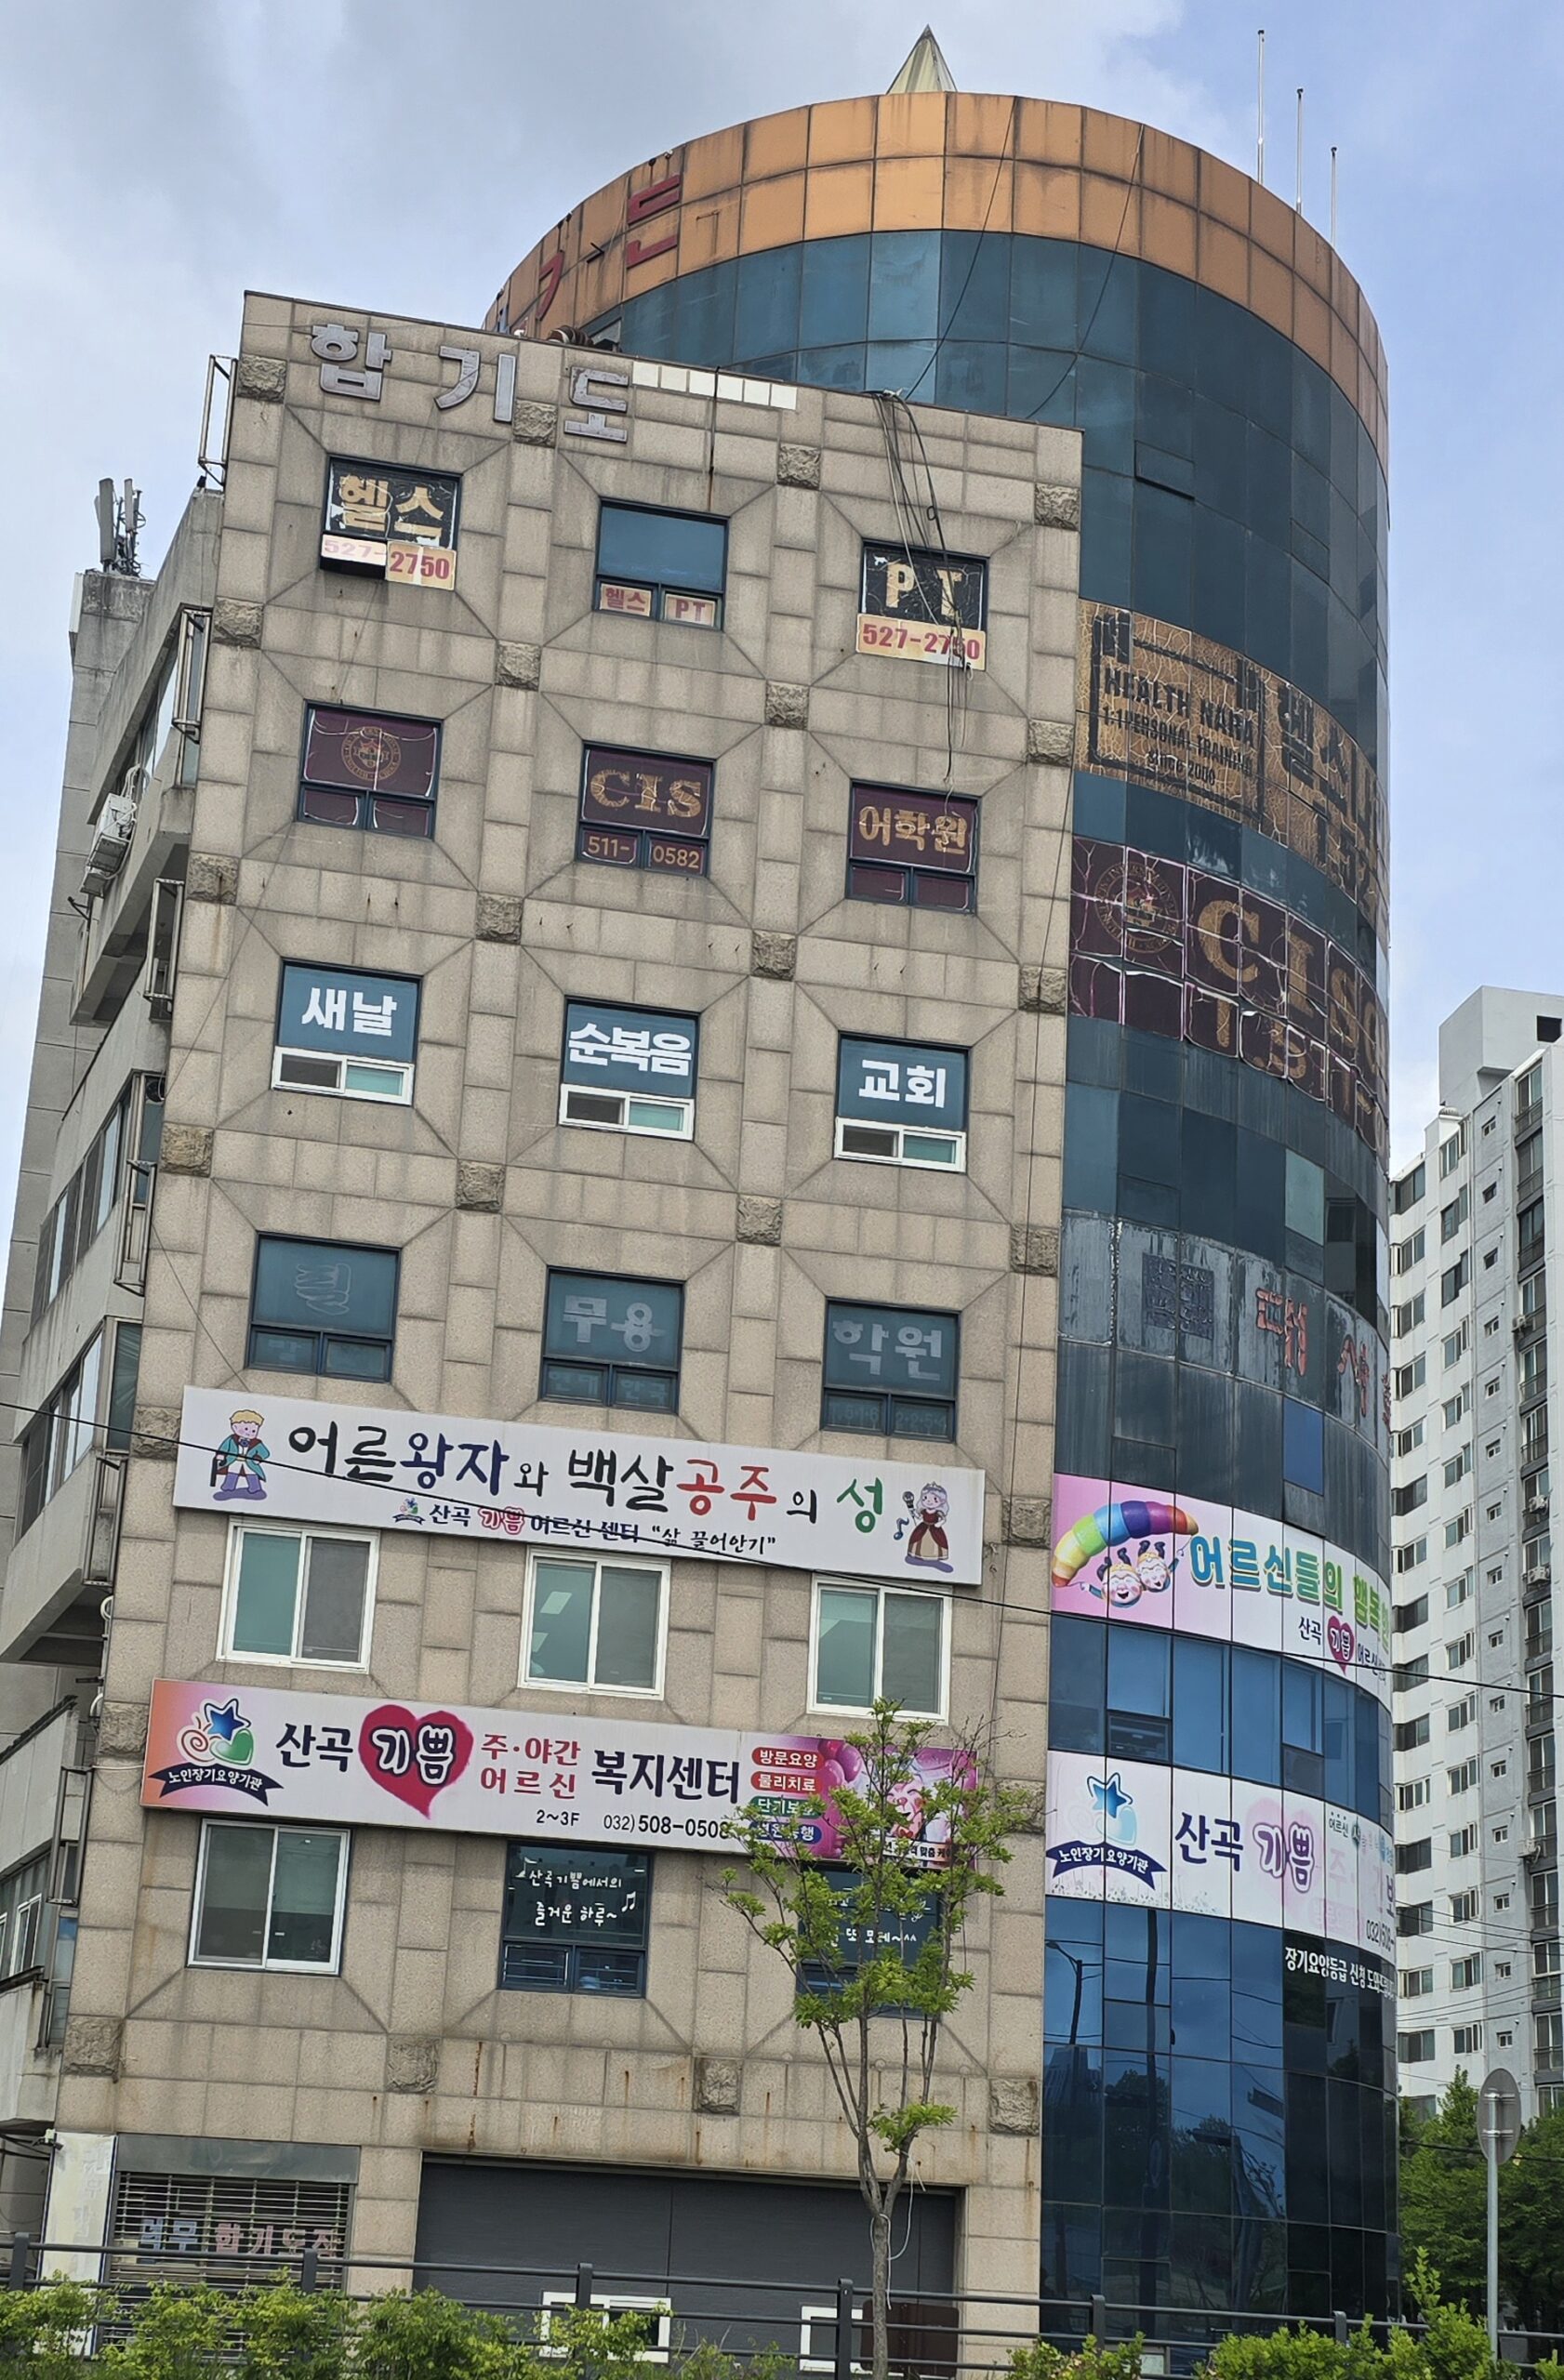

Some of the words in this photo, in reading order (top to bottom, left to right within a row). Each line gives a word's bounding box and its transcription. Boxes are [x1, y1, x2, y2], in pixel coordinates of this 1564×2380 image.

[311, 324, 630, 443] 합기도
[338, 474, 445, 537] 헬스
[389, 550, 451, 581] 2750
[885, 560, 964, 618] PT
[604, 587, 647, 614] 헬스
[674, 599, 708, 620] PT
[862, 624, 981, 661] 527-2750
[1104, 667, 1190, 720] HEALTH
[590, 768, 702, 818] CIS
[858, 803, 968, 855] 어학원
[301, 986, 398, 1037] 새날
[568, 1023, 693, 1077] 순복음
[858, 1059, 947, 1108] 교회
[563, 1294, 665, 1353] 무용
[832, 1319, 942, 1381] 학원
[429, 1503, 471, 1527] 산곡
[477, 1504, 526, 1536] 기쁨
[530, 1513, 592, 1539] 어르신
[601, 1520, 640, 1544] 센터
[837, 1476, 883, 1534] 성
[1190, 1535, 1344, 1615] 어르신들의
[1298, 1616, 1323, 1646] 산곡
[1330, 1627, 1353, 1663] 기쁨
[275, 1723, 353, 1773] 산곡
[371, 1724, 454, 1786] 기쁨
[591, 1747, 739, 1805] 복지센터
[759, 1747, 818, 1770] 방문요양
[168, 1768, 263, 1792] 노인장기요양기관
[481, 1765, 577, 1800] 어르신
[758, 1772, 816, 1794] 물리치료
[536, 1809, 581, 1827] 2~3F
[1058, 1845, 1150, 1874] 노인장기요양기관
[1174, 1811, 1244, 1872] 산곡
[1253, 1819, 1315, 1895] 기쁨
[535, 1901, 573, 1926] 즐거운
[1284, 1947, 1347, 1982] 장기요양등급
[1348, 1962, 1367, 1990] 신청
